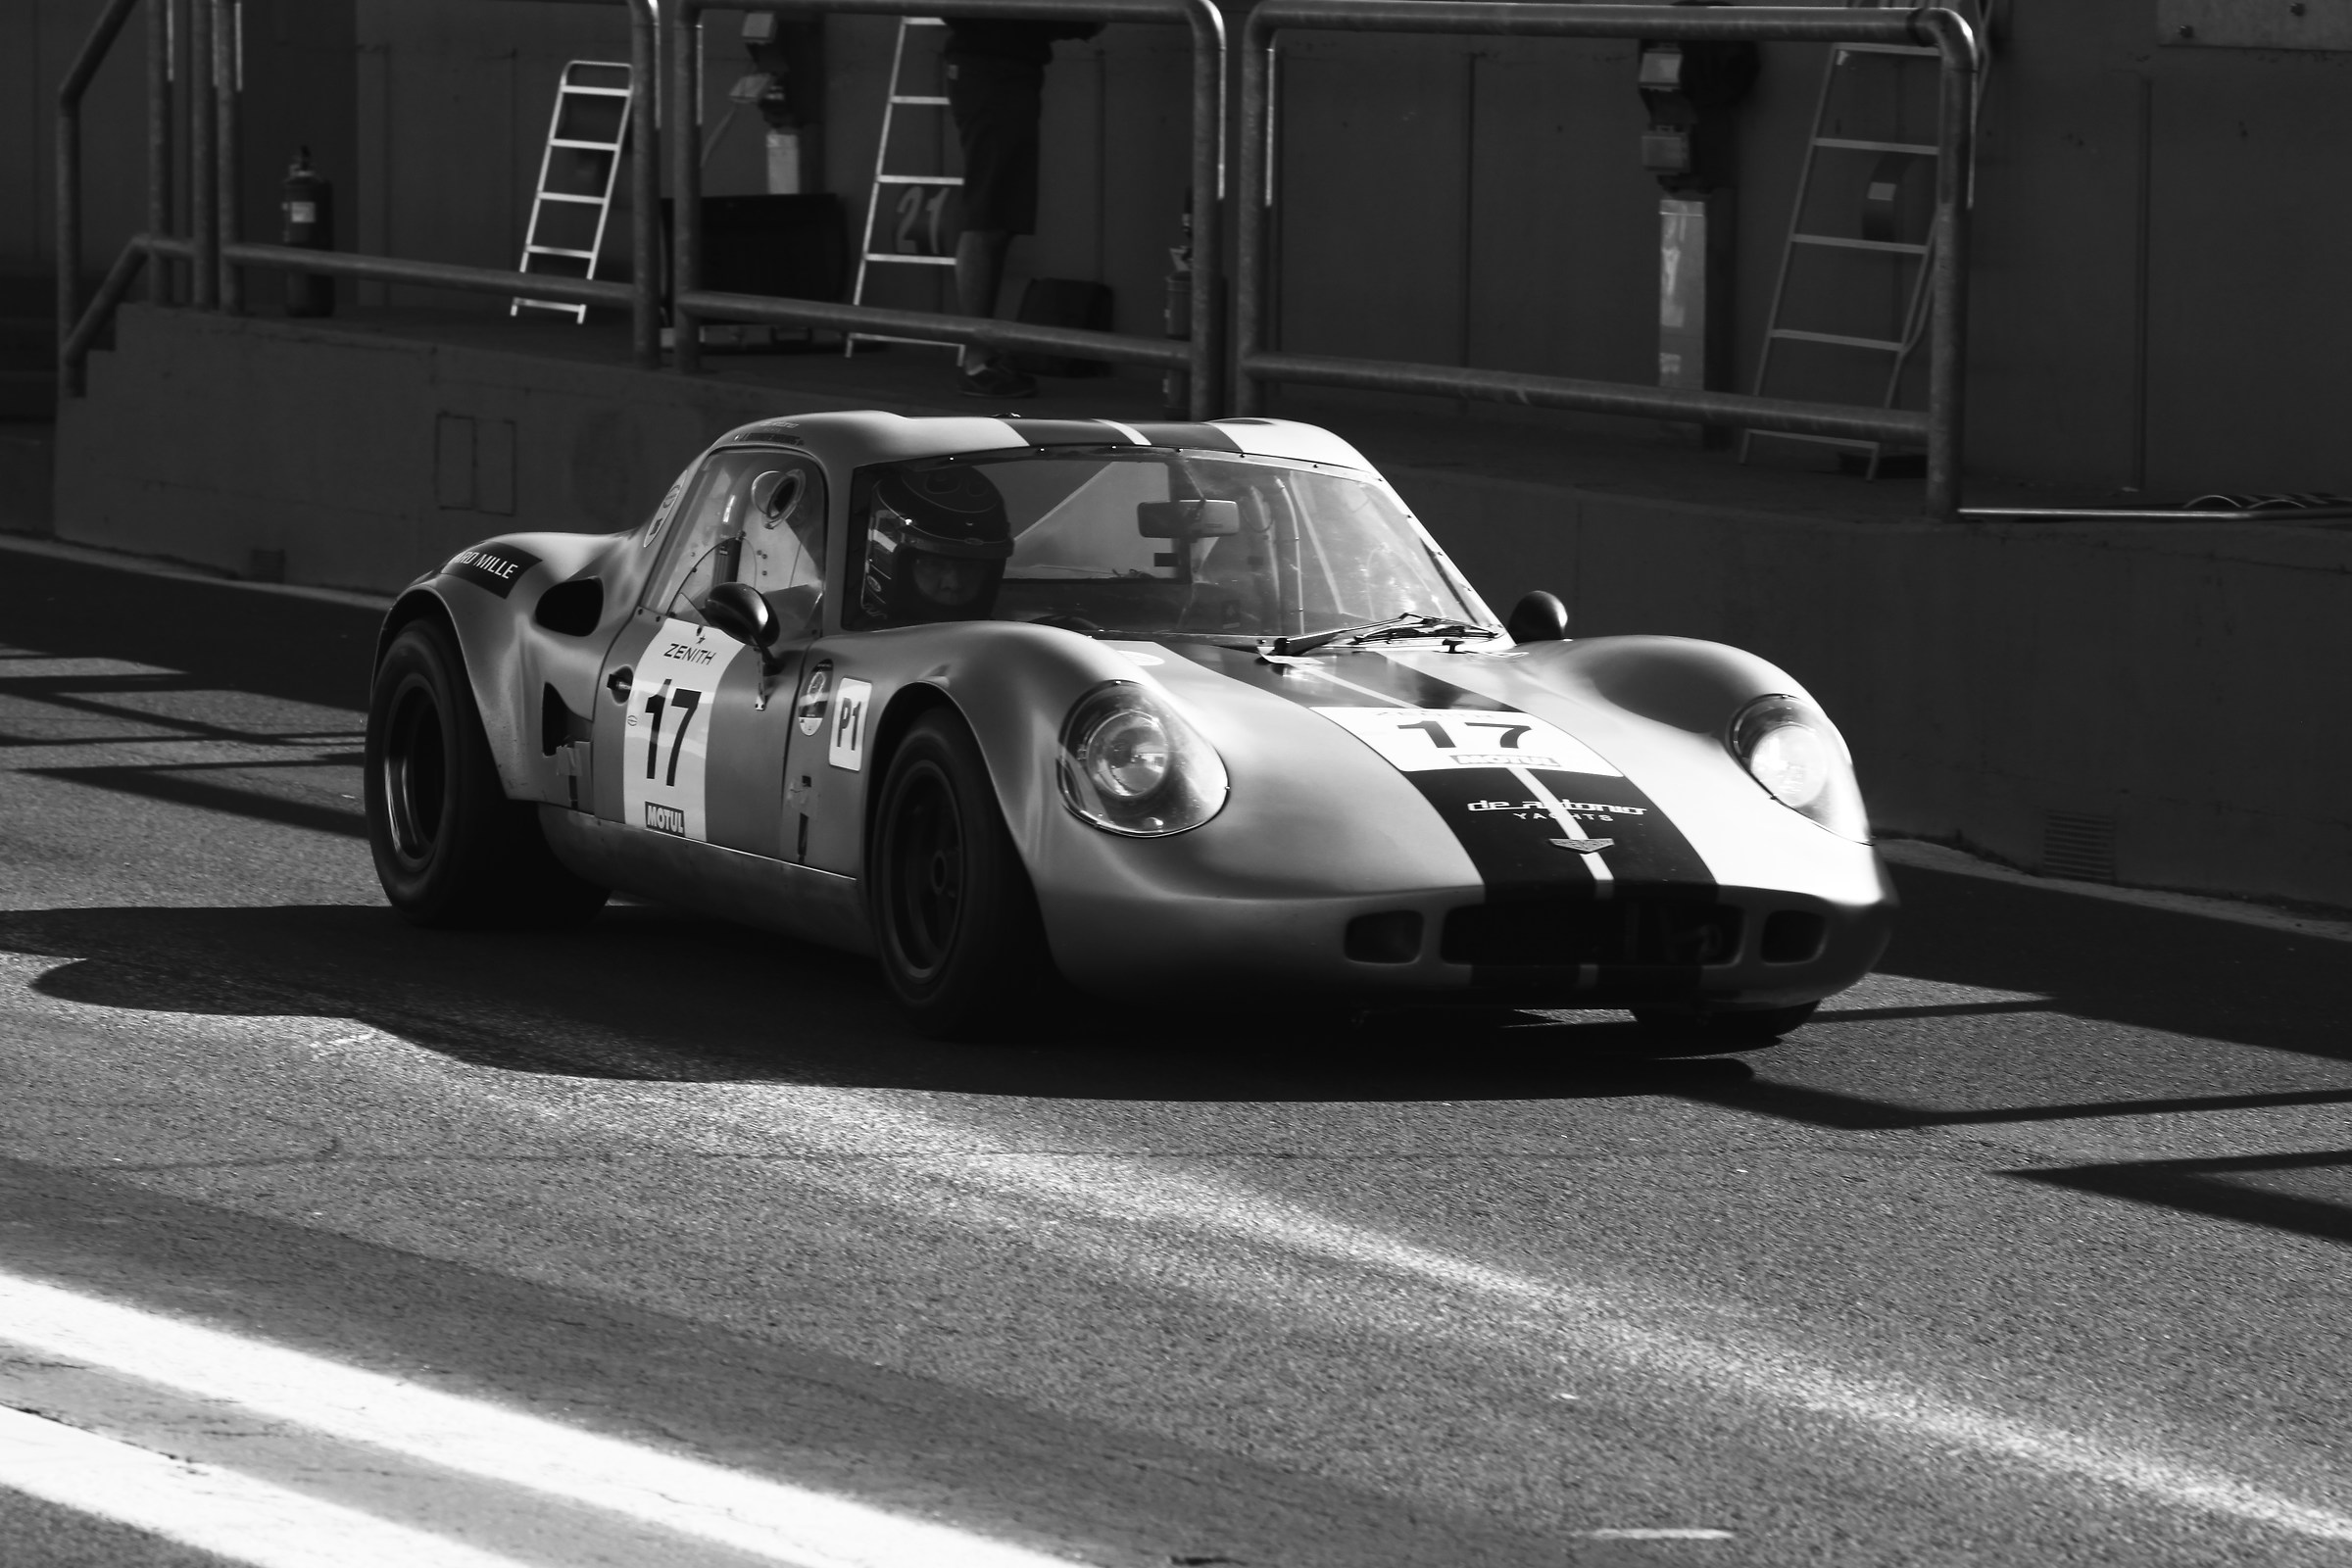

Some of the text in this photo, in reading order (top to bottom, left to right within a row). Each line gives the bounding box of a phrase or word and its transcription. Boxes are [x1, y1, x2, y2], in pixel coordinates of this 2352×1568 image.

[896, 185, 951, 255] 21
[472, 554, 518, 579] MILLE
[663, 643, 716, 665] ZENITH
[645, 678, 702, 787] 17
[836, 698, 862, 751] P1
[1396, 720, 1533, 748] 17
[1454, 754, 1558, 767] MOTUL
[647, 805, 685, 834] MOTUL
[1467, 799, 1647, 815] de atonio
